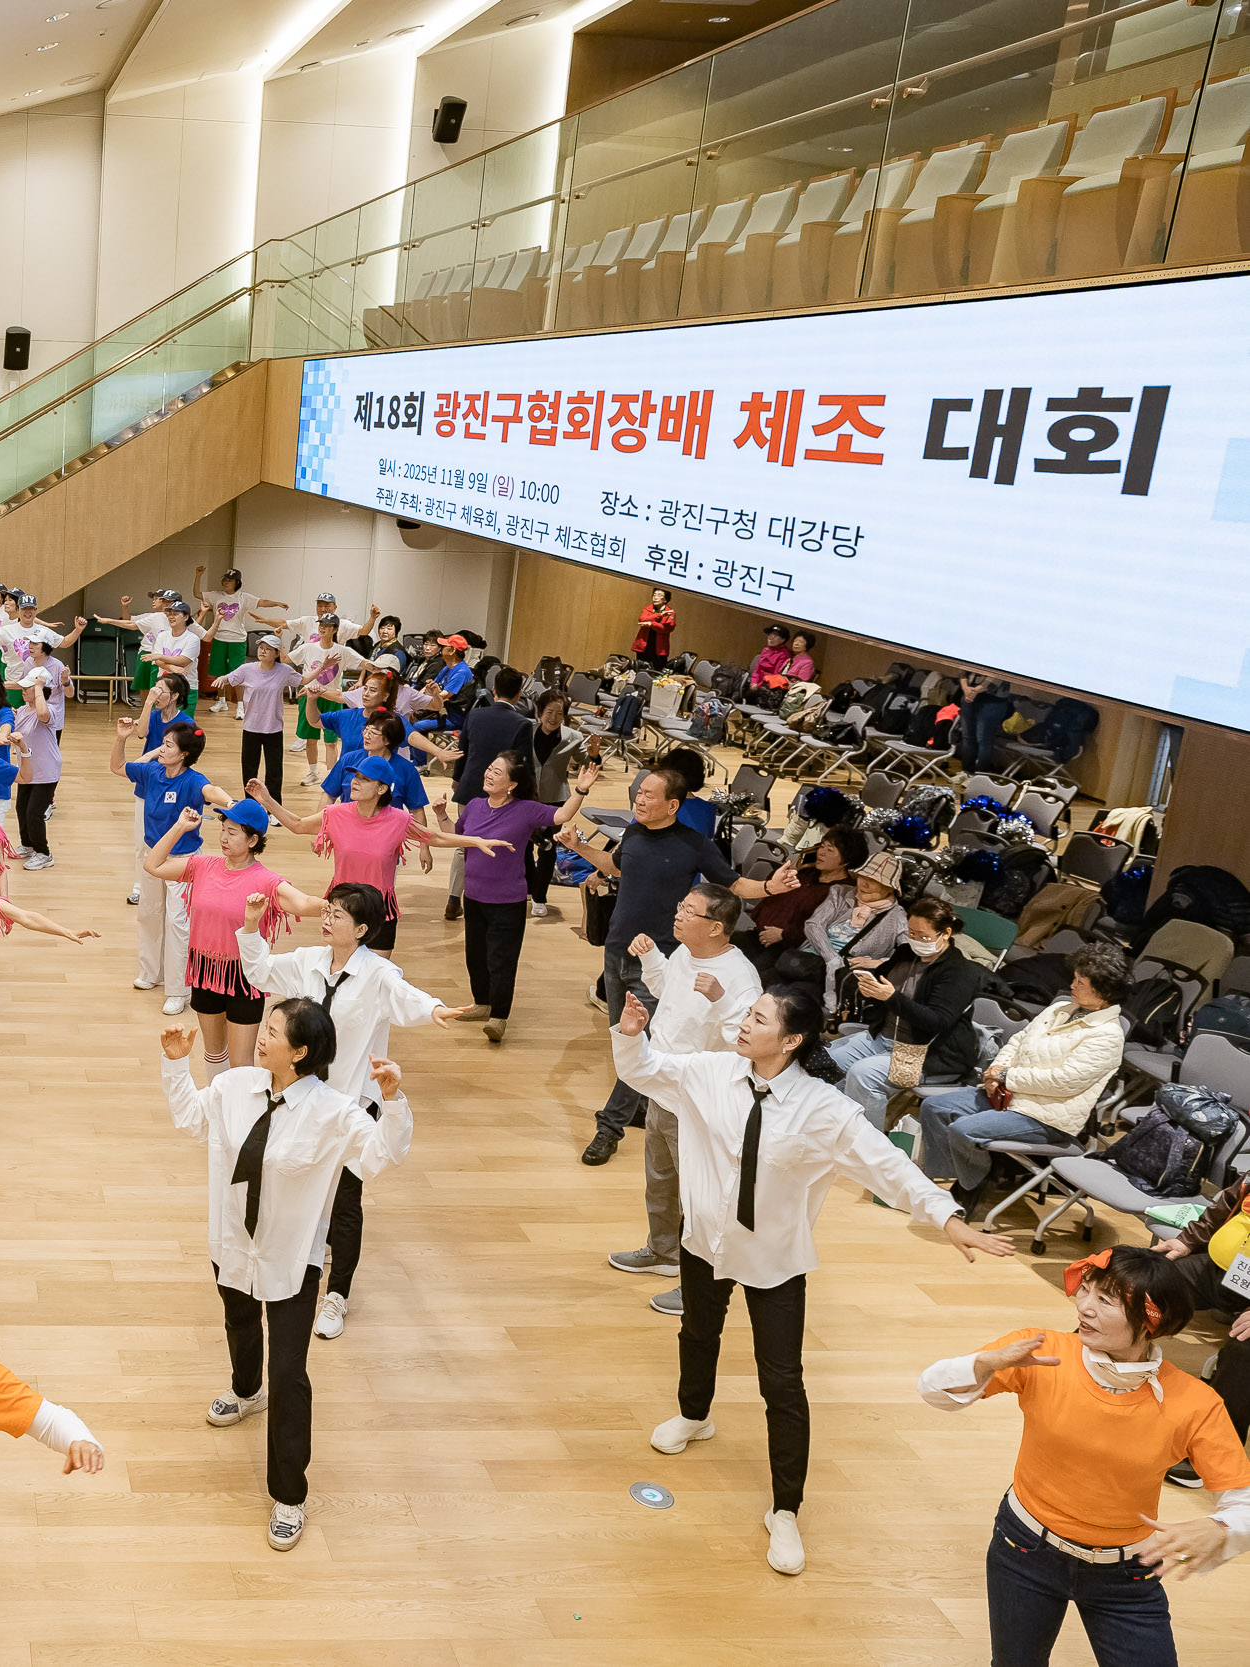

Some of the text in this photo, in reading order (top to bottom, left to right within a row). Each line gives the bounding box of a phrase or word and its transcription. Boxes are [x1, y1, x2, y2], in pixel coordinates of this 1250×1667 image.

[354, 385, 1171, 496] 제18회 광진구협회장배 체조 대회
[378, 458, 396, 477] 일시
[403, 462, 438, 485] 2025년
[440, 468, 465, 489] 11월
[468, 472, 488, 494] 9일
[492, 474, 515, 500] (일)
[519, 480, 560, 505] 10:00
[424, 497, 457, 522] 광진구
[505, 515, 550, 543] 광진구
[554, 525, 627, 563] 체조협회
[600, 490, 639, 518] 장소
[659, 500, 757, 540] 광진구청
[768, 517, 865, 558] 대강당
[22, 595, 35, 603] NY
[644, 544, 690, 578] 후원
[712, 558, 795, 603] 광진구
